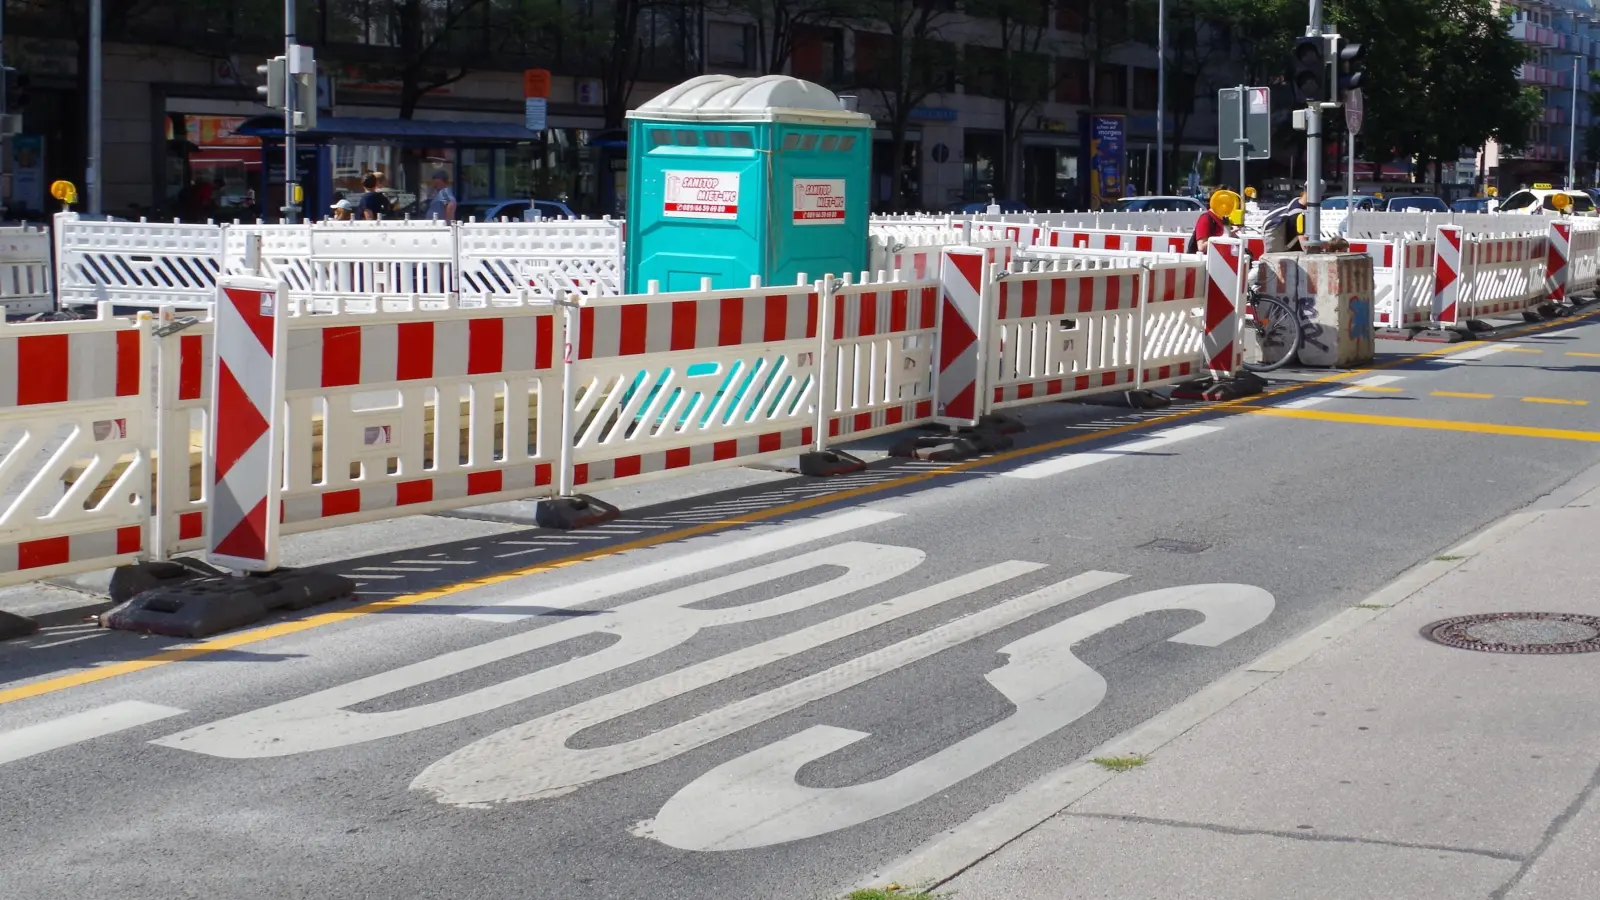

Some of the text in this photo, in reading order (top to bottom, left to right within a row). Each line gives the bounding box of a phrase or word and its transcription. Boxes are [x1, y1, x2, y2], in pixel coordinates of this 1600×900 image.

[682, 176, 719, 189] SANITOP
[697, 189, 737, 202] MIET-WC
[805, 184, 832, 196] SANITOP
[816, 196, 844, 208] MIET-WC
[147, 540, 1275, 852] BUS
